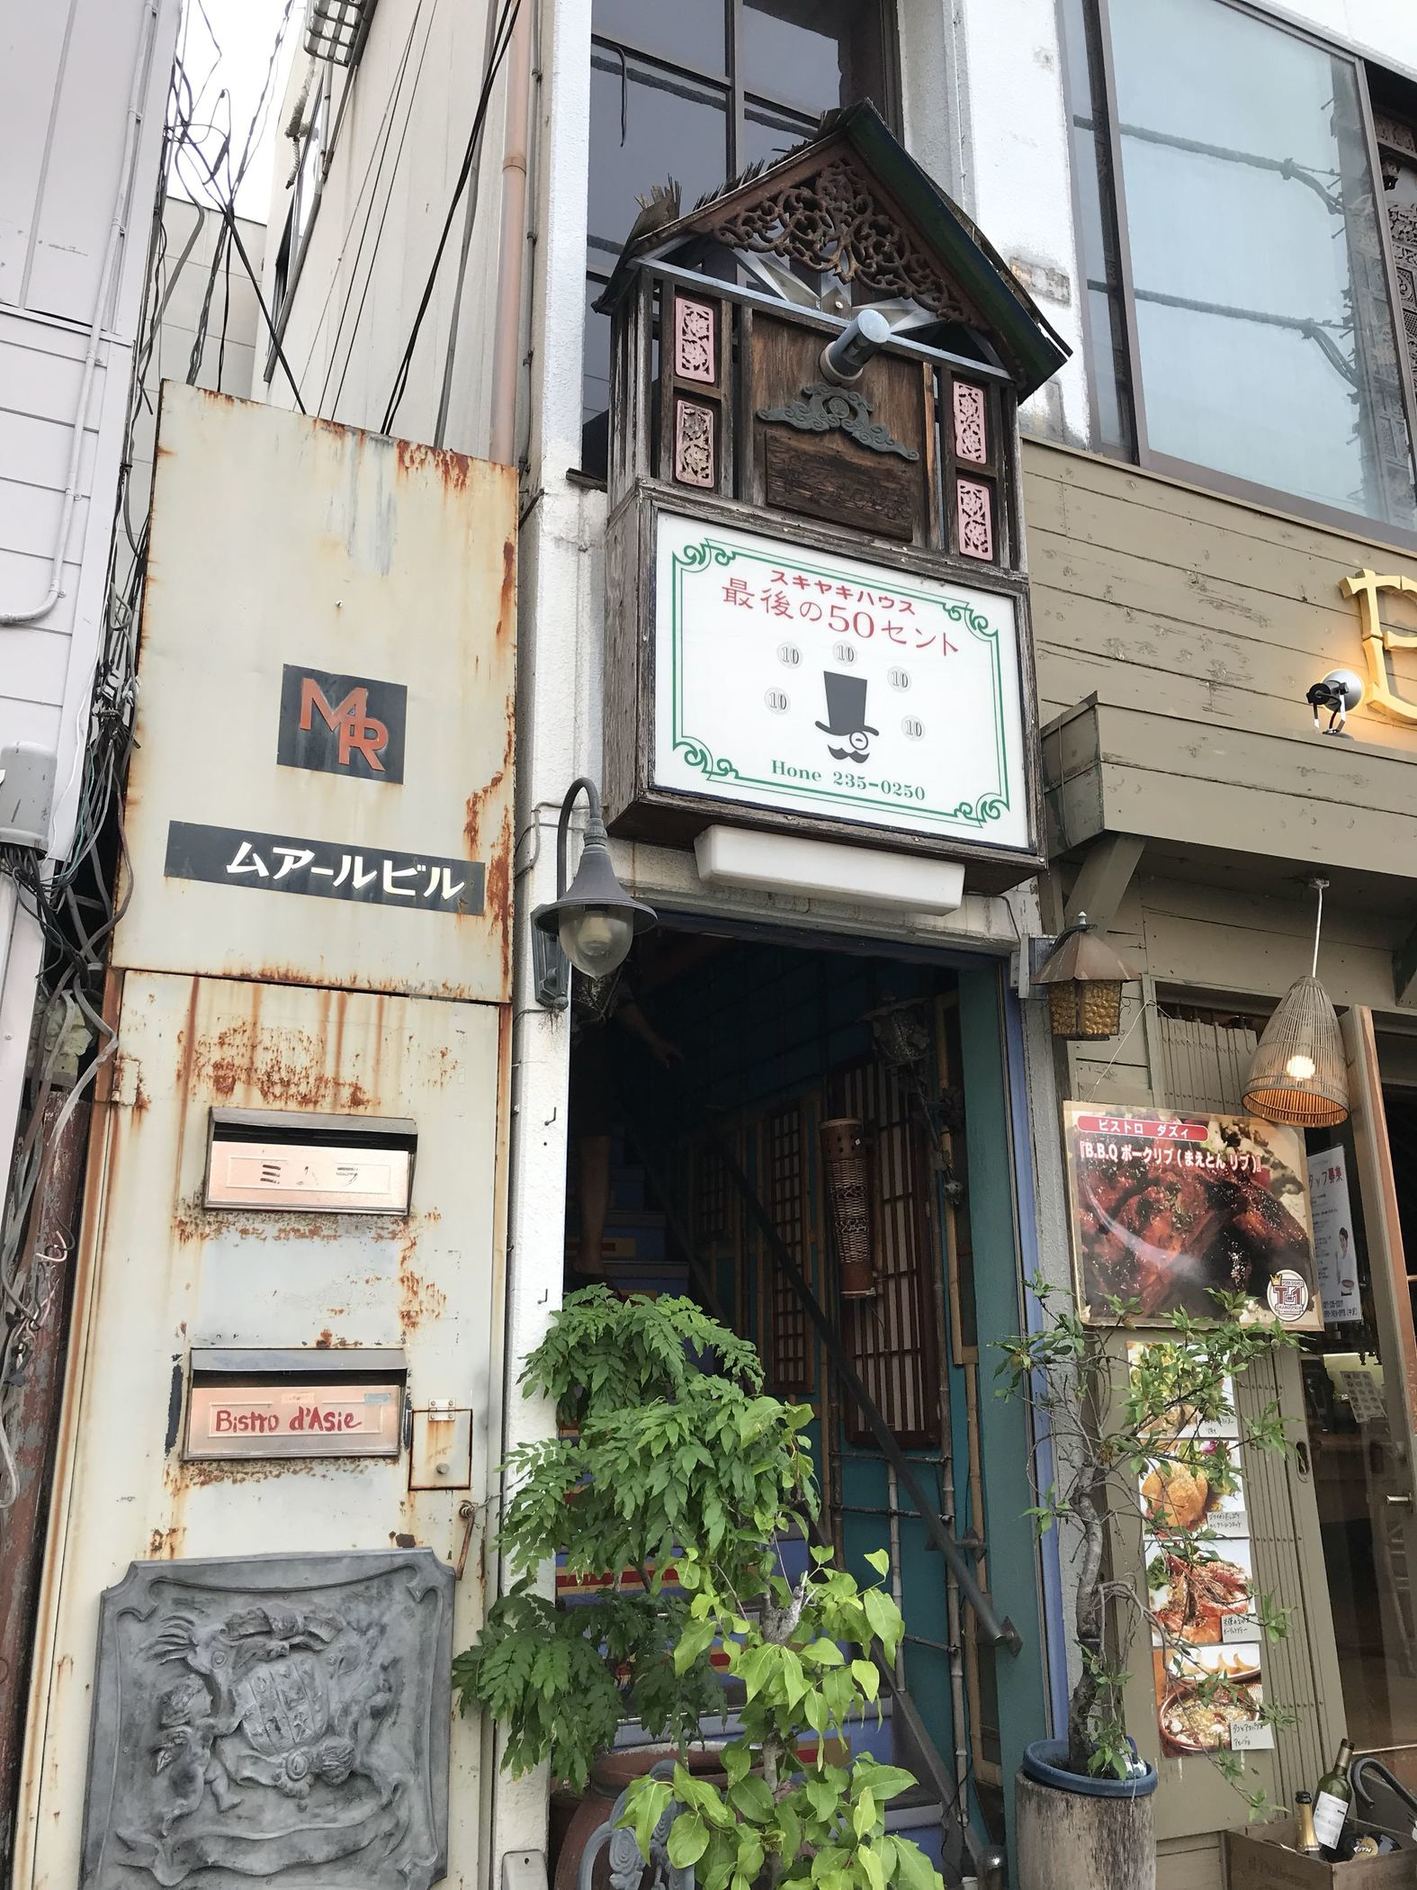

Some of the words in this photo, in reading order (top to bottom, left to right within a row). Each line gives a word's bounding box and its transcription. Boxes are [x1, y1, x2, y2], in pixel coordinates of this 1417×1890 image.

[770, 569, 916, 616] スキヤキハウス
[721, 576, 959, 657] 最後の50セント
[771, 759, 823, 784] Hone
[832, 770, 926, 802] 235-0250
[225, 840, 466, 901] ムアールビル
[1098, 1118, 1144, 1134] ビストロ
[215, 1409, 280, 1434] Bistro
[288, 1406, 363, 1432] d'Asie
